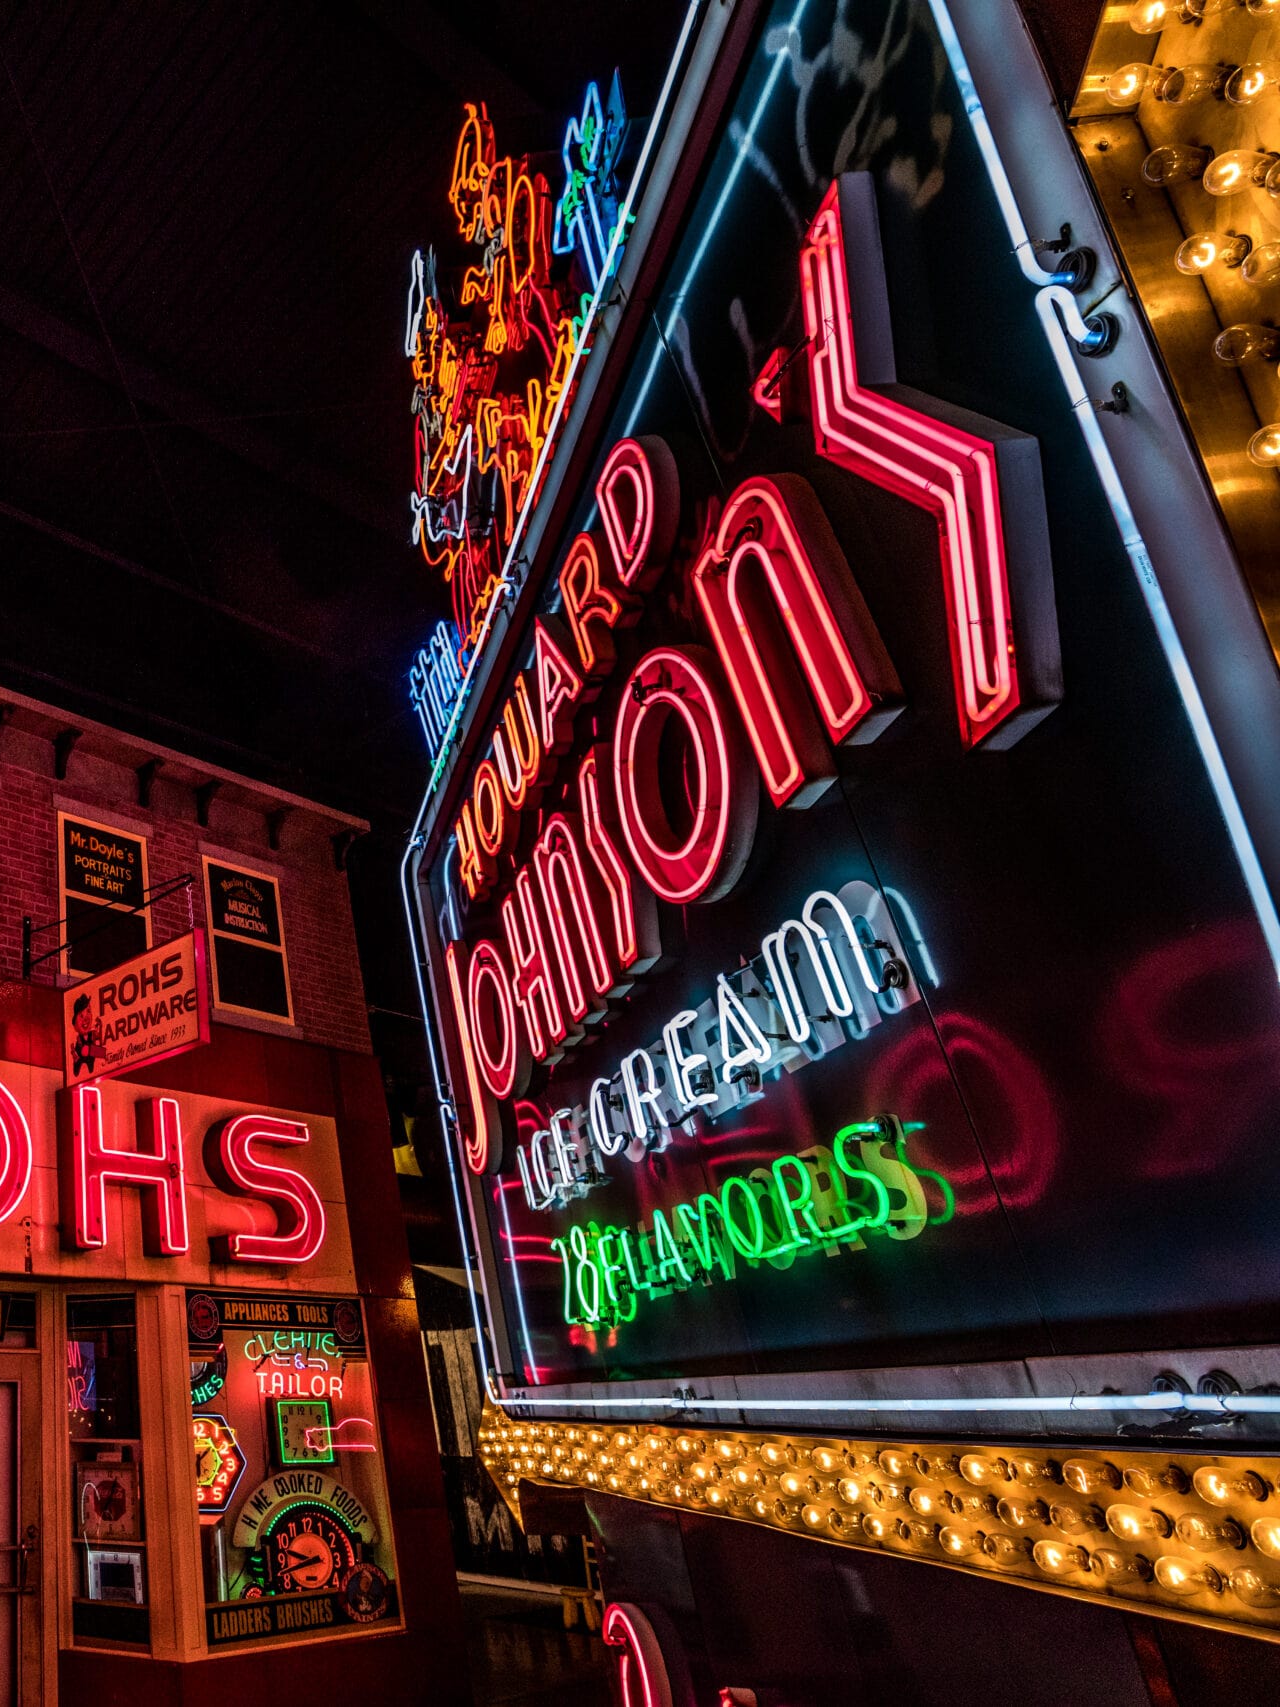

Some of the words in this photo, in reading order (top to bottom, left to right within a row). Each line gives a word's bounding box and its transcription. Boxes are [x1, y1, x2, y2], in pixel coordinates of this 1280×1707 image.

[457, 437, 656, 900] HOWARD
[70, 830, 89, 849] Mr.
[90, 837, 134, 864] Doyle's
[74, 854, 132, 881] PORTRAITS
[85, 873, 105, 889] FINE
[106, 880, 124, 895] ART
[228, 898, 261, 919] MUSICAL
[224, 912, 268, 935] INSTRUCTION
[98, 951, 184, 1017] ROHS
[102, 1046, 124, 1067] Family
[125, 1039, 148, 1059] Owned
[149, 1033, 167, 1049] Since
[170, 1024, 186, 1041] 1933
[517, 1106, 588, 1212] ICE
[590, 888, 898, 1160] CREAM
[598, 1118, 894, 1302] FLAVORS
[224, 1302, 290, 1322] APPLIANCES
[296, 1304, 329, 1324] TOOLS
[294, 1352, 307, 1370] &
[255, 1371, 343, 1400] TAILOR
[193, 1424, 206, 1438] 12
[215, 1423, 219, 1438] 1
[219, 1440, 230, 1455] 2
[225, 1458, 237, 1472] 3
[216, 1472, 228, 1486] 4
[212, 1487, 223, 1501] 5
[330, 1485, 368, 1529] FOODS
[288, 1522, 297, 1537] 11
[301, 1517, 313, 1533] 12
[317, 1522, 323, 1537] 1
[276, 1533, 289, 1550] 10
[328, 1532, 337, 1548] 2
[277, 1552, 286, 1568] 9
[333, 1552, 342, 1568] 3
[283, 1574, 291, 1590] 8
[213, 1606, 272, 1640] LADDERS
[276, 1597, 334, 1631] BRUSHES
